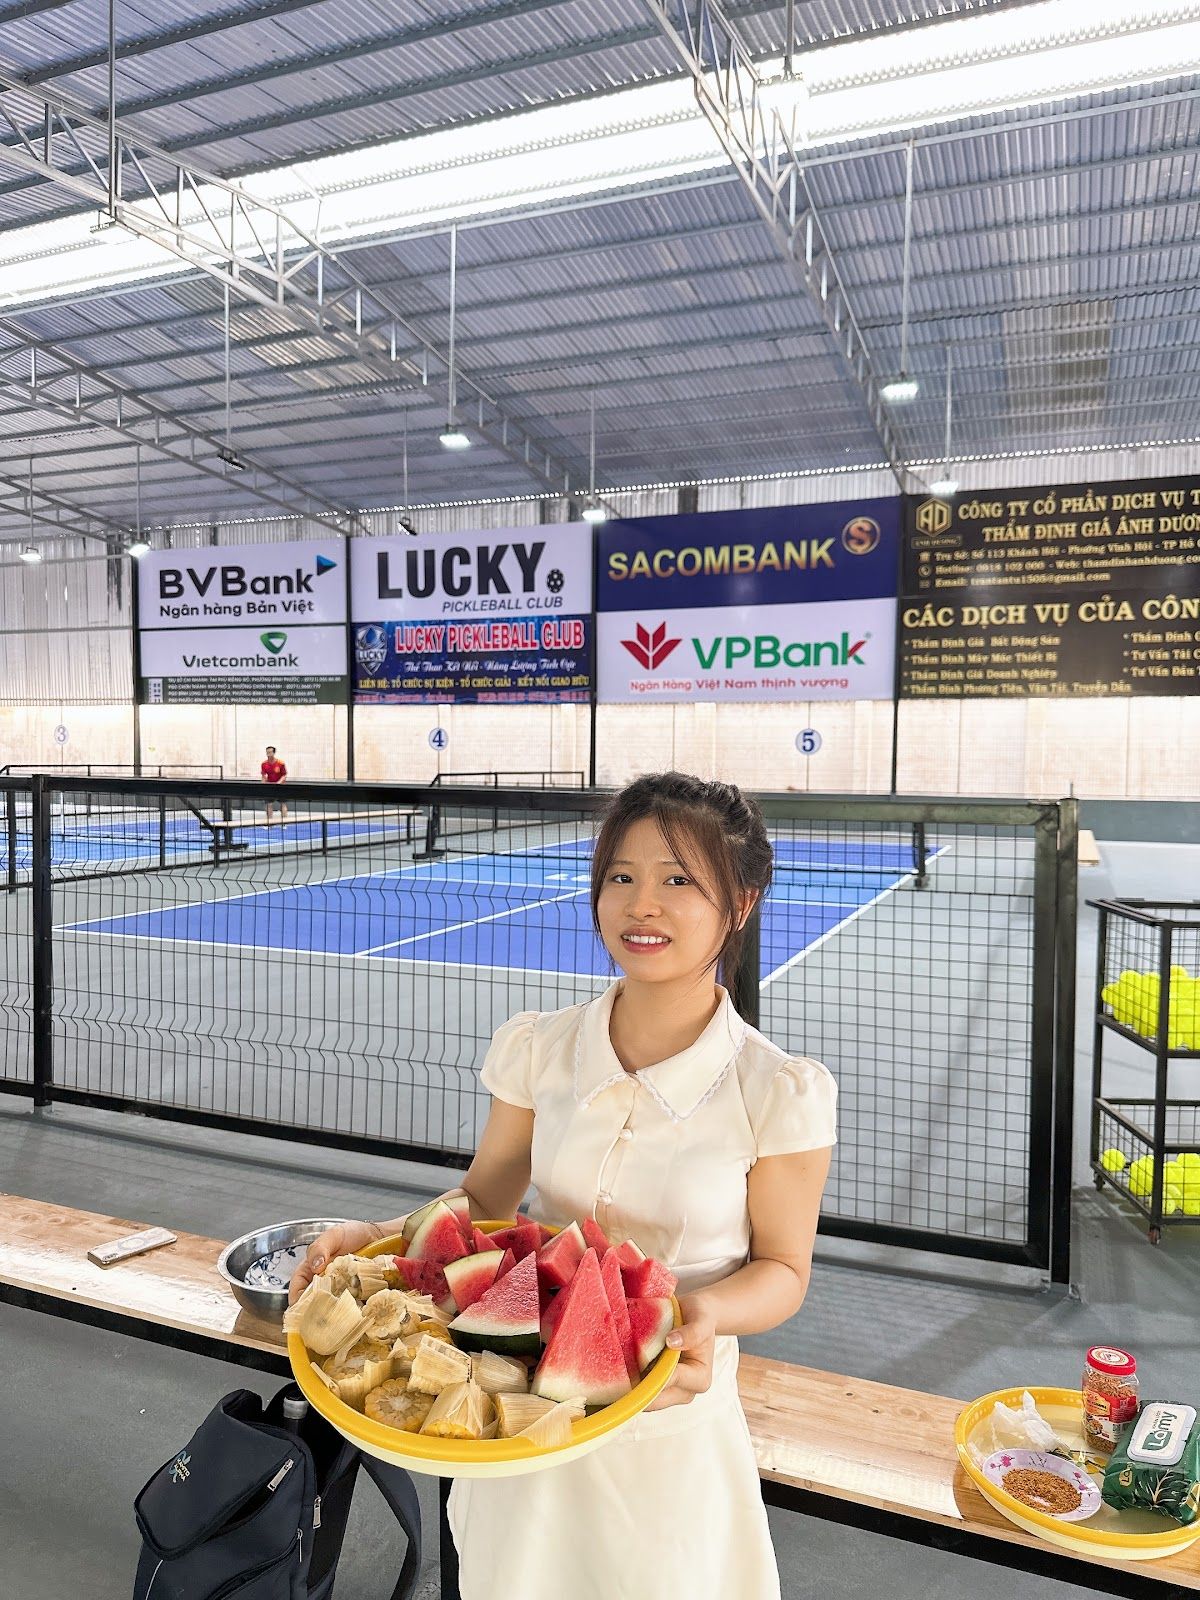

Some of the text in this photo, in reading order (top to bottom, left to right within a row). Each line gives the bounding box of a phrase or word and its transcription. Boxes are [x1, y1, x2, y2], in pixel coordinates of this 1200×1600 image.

[958, 500, 1003, 520] CÔNG
[1007, 501, 1030, 517] TY
[1032, 489, 1057, 515] CỔ
[1061, 488, 1108, 513] PHẦN
[1111, 491, 1156, 513] DỊCH
[1160, 490, 1185, 510] VỤ
[982, 518, 1031, 542] THẨM
[1034, 522, 1077, 543] ĐỊNH
[1081, 516, 1112, 538] GIÁ
[1115, 515, 1154, 536] ÁNH
[1161, 540, 1178, 551] TP
[377, 541, 546, 599] LUCKY
[608, 537, 836, 581] SACOMBANK
[159, 566, 314, 599] BVBank
[160, 600, 314, 619] Ngân hàng Bản Việt
[442, 596, 564, 613] PICKLEBALL CLUB
[903, 602, 955, 628] CÁC
[961, 604, 1027, 630] DỊCH
[1033, 602, 1070, 627] VỤ
[1078, 594, 1136, 623] CỦA
[395, 619, 585, 654] LUCKY PICKLEBALL CLUB
[182, 653, 299, 668] Vietcombank
[692, 632, 867, 669] VPBank
[631, 677, 848, 691] Ngân Hàng Việt Nam thịnh vượng
[57, 726, 67, 743] 3
[433, 731, 445, 748] 4
[801, 731, 815, 752] 5
